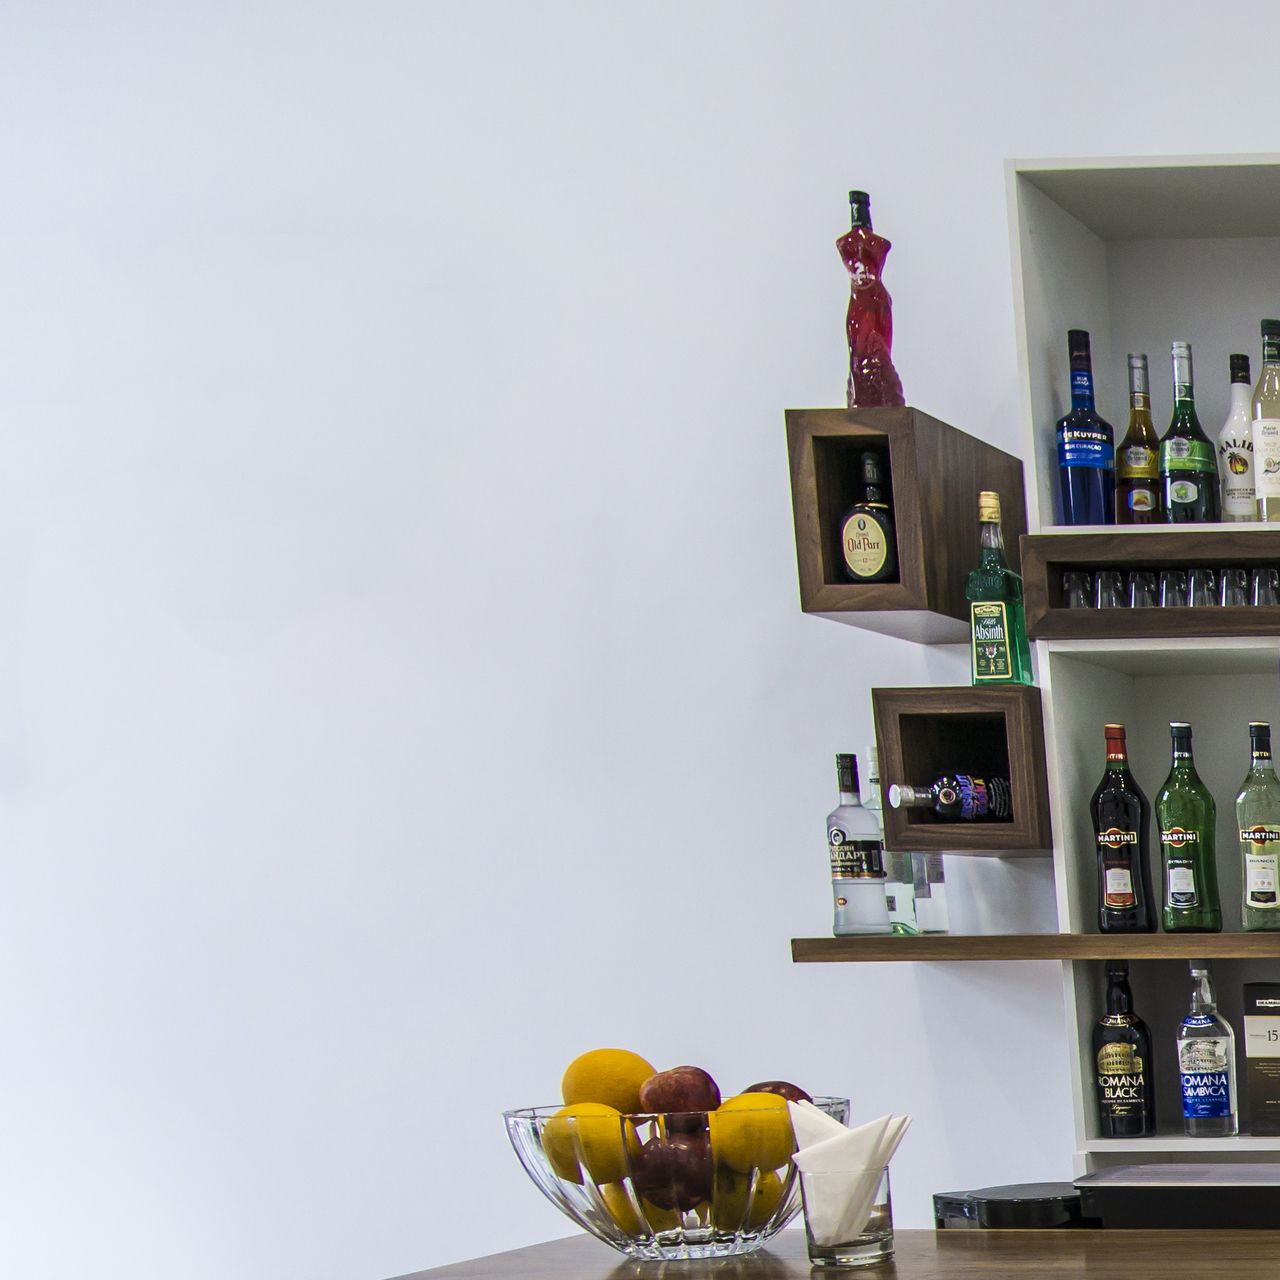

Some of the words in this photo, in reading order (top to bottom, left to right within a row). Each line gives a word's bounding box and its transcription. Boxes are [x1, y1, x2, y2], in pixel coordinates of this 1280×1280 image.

[1073, 430, 1108, 441] KUYPER
[847, 537, 862, 552] Old
[862, 537, 880, 552] Parr
[975, 624, 1004, 640] Absinth
[1098, 833, 1135, 842] MARTINI
[1161, 833, 1196, 842] MARTINI
[1241, 832, 1280, 841] MARTINI
[1266, 1029, 1279, 1042] 15
[1104, 1087, 1138, 1099] BLACK
